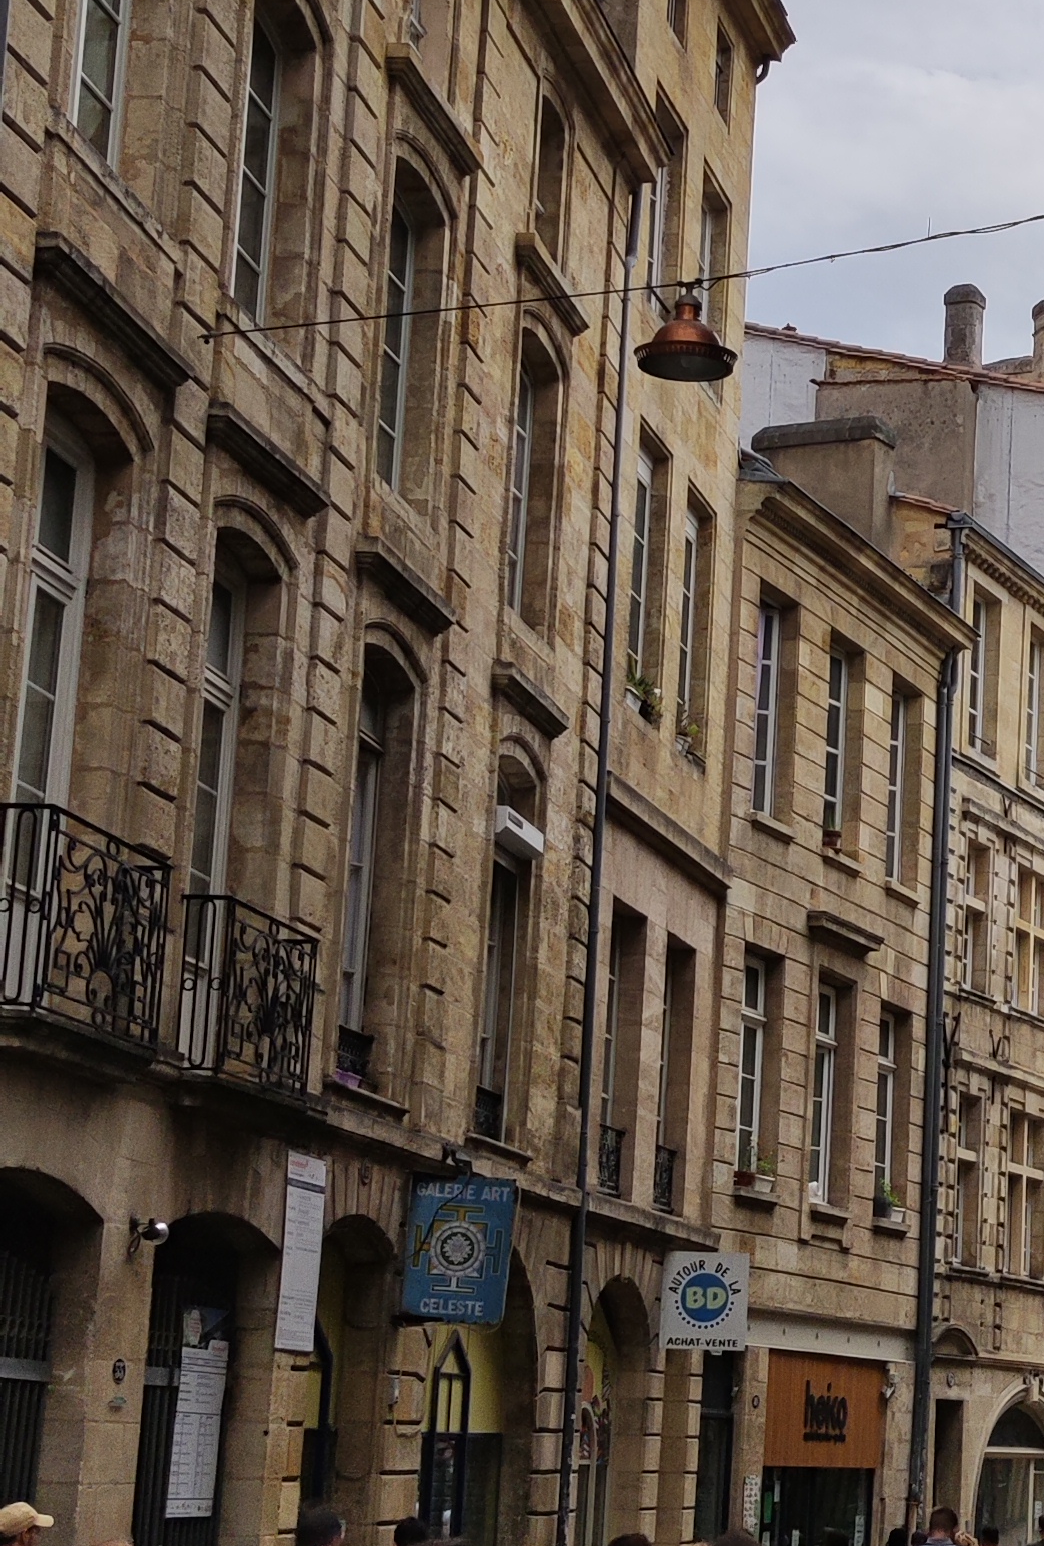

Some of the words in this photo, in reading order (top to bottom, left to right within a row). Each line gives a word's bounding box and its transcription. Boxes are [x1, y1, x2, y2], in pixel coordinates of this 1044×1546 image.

[416, 1182, 477, 1201] GALERIE
[481, 1186, 511, 1202] ART
[668, 1259, 706, 1295] AUTOUR
[714, 1262, 731, 1278] DE
[728, 1280, 741, 1296] LA
[420, 1298, 484, 1316] CELESTE
[686, 1286, 727, 1310] BD
[666, 1337, 738, 1348] ACHAT-VENTE
